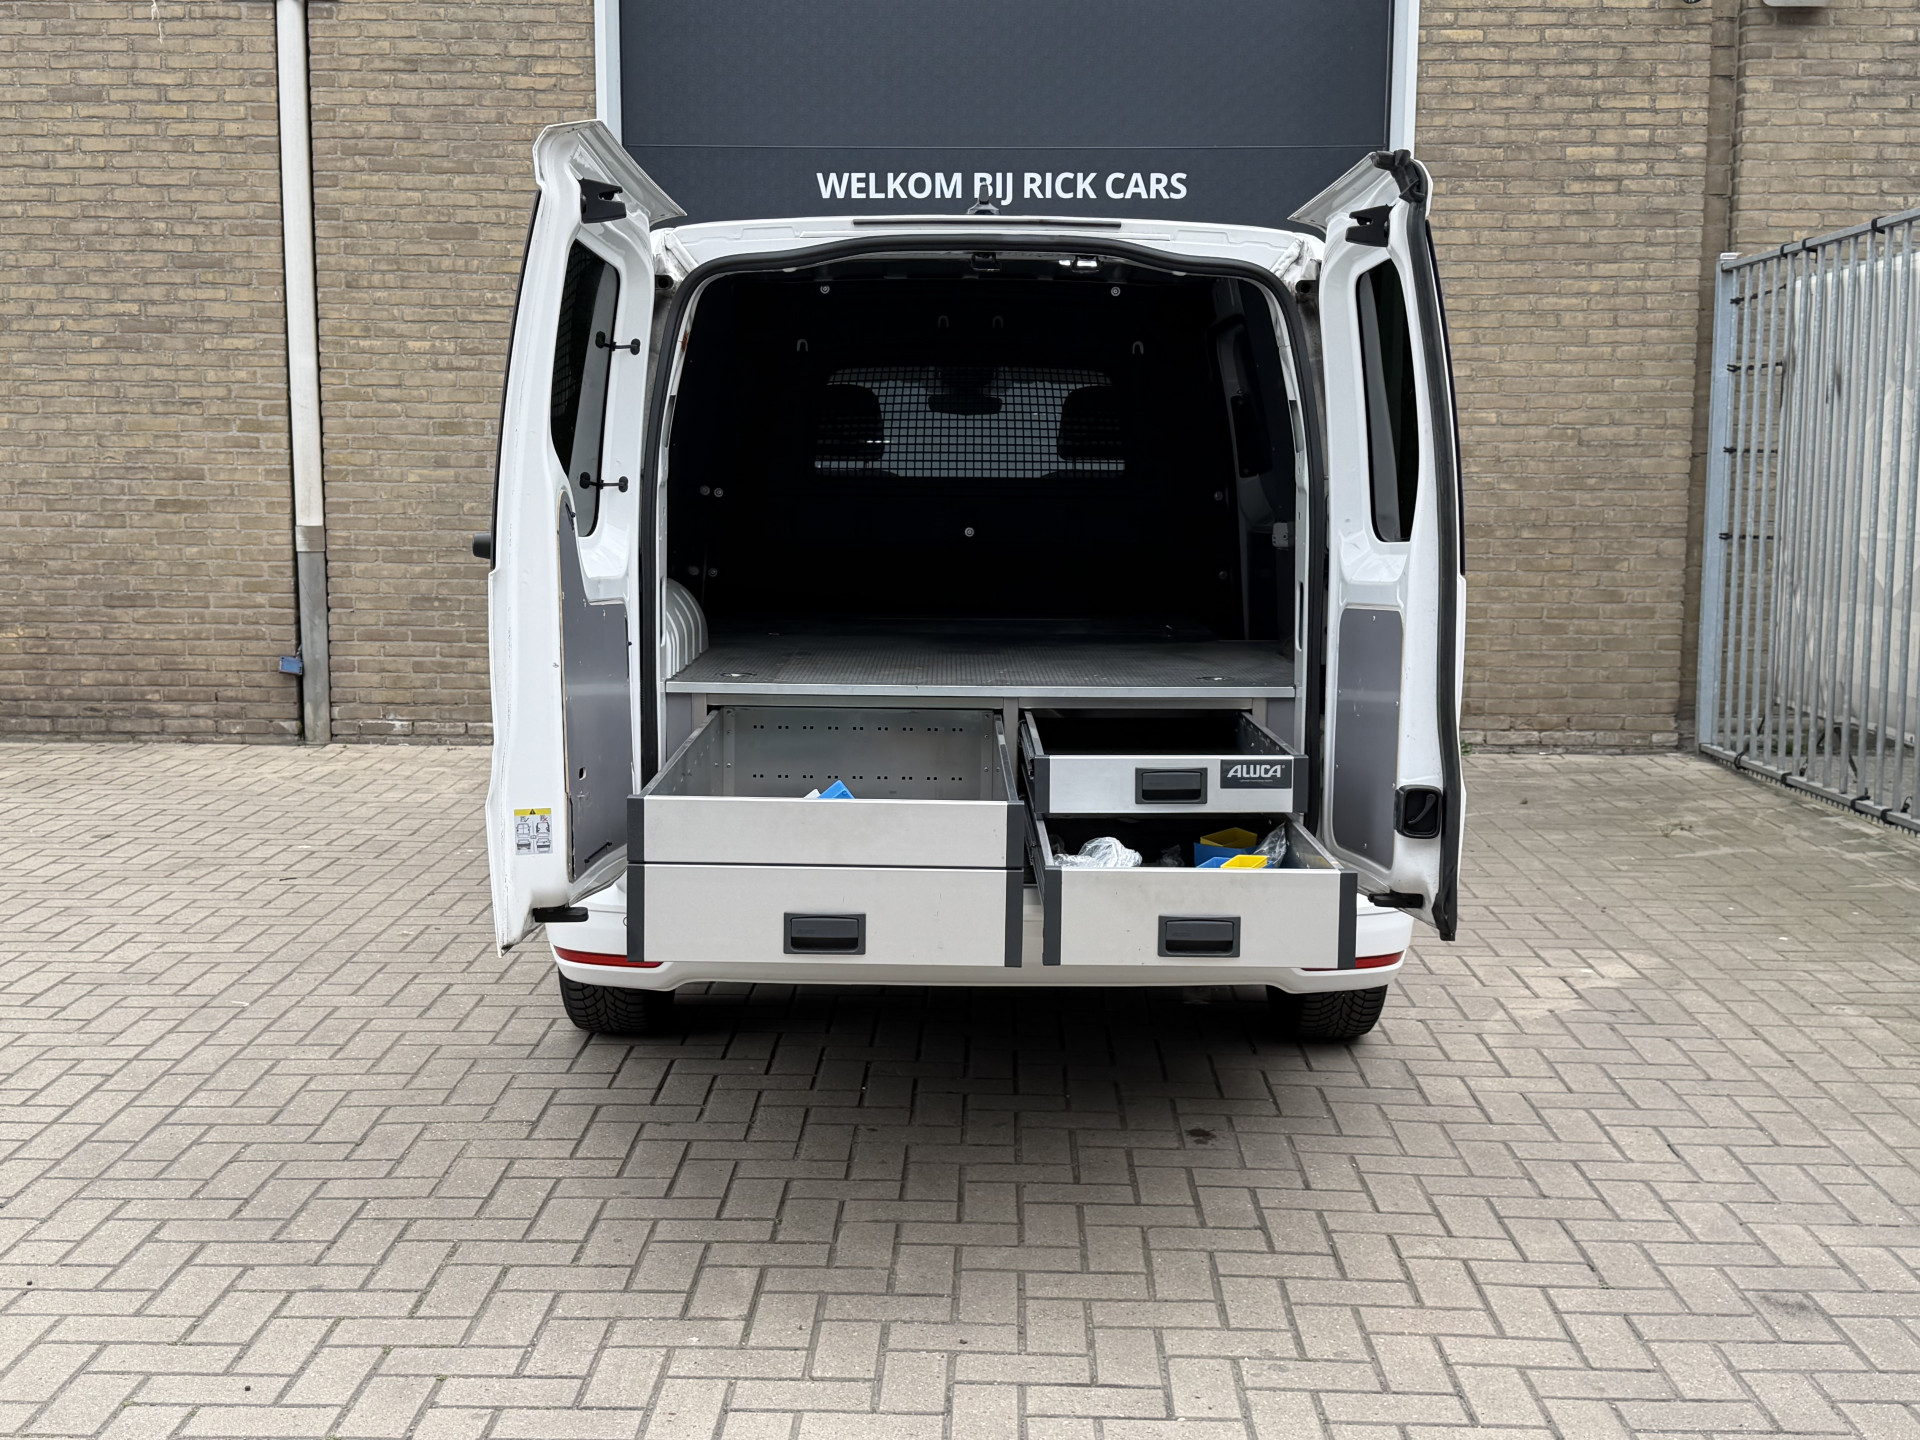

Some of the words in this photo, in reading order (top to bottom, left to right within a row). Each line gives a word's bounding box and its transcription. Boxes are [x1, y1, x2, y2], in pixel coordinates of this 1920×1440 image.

[816, 172, 963, 199] WELKOM
[973, 172, 1014, 206] BIJ
[1023, 172, 1098, 199] RICK
[1105, 172, 1188, 199] CARS
[1226, 764, 1282, 778] ALUCA
